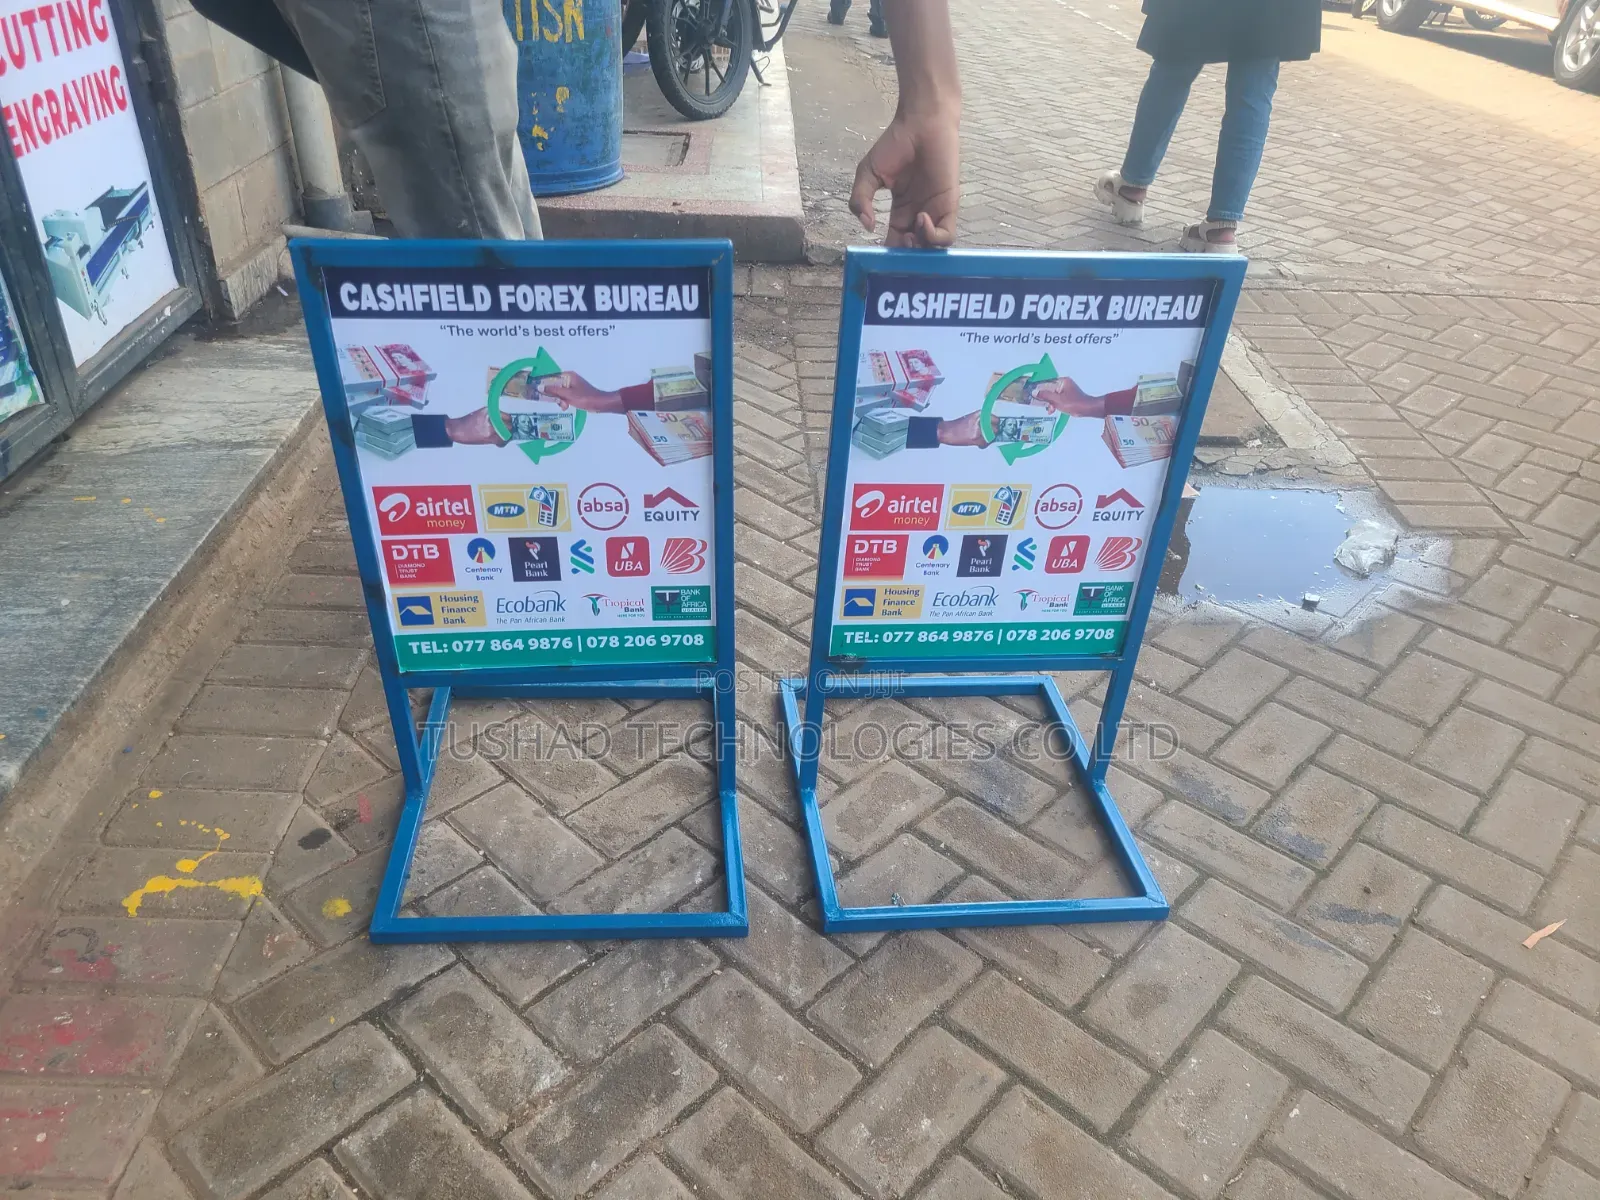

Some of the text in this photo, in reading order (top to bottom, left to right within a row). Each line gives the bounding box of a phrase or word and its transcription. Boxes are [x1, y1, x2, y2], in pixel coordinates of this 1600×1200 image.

[2, 65, 128, 159] ENGRAVING
[340, 282, 700, 312] CASHFIELD FOREX BUREAU
[877, 291, 1204, 322] CASHFIELD FOREX BUREAU
[477, 324, 530, 337] world’s
[534, 324, 564, 337] best
[993, 332, 1041, 345] world’s
[1044, 332, 1072, 345] best
[415, 496, 473, 517] airtel
[493, 505, 518, 515] MTN
[583, 497, 624, 513] absa
[887, 495, 938, 514] airtel
[957, 504, 982, 514] MTN
[1039, 497, 1077, 512] absa
[644, 510, 701, 522] EQUITY
[893, 516, 931, 527] money
[1092, 510, 1145, 522] EQUITY
[426, 519, 466, 530] money
[391, 543, 440, 560] DTB
[854, 539, 898, 554] DTB
[524, 560, 548, 569] Pearl
[614, 560, 643, 572] UBA
[915, 561, 951, 569] Centenary
[970, 557, 993, 566] Pearl
[1051, 558, 1079, 569] UBA
[464, 566, 503, 574] Centenary
[525, 569, 549, 577] Bank
[969, 565, 991, 574] Bank
[680, 588, 701, 596] BANK
[884, 587, 920, 597] Housing
[1104, 584, 1125, 592] BANK
[439, 594, 480, 603] Housing
[496, 590, 567, 613] Ecobank
[932, 585, 1000, 607] Ecobank
[1031, 594, 1070, 605] Tropical
[602, 598, 645, 608] Tropical
[883, 598, 916, 606] Finance
[441, 605, 477, 614] Finance
[882, 608, 903, 616] Bank
[929, 610, 940, 618] The
[443, 616, 466, 625] Bank
[495, 617, 508, 625] The
[524, 616, 547, 624] African
[844, 631, 880, 644] TEL:
[882, 630, 916, 643] 077
[917, 630, 949, 643] 864
[952, 629, 994, 642] 9876
[1006, 629, 1037, 641] 078
[1040, 628, 1071, 641] 206
[1074, 628, 1115, 640] 9708
[408, 640, 449, 654] TEL:
[452, 639, 485, 653] 077
[490, 638, 524, 652] 864
[528, 636, 573, 651] 9876
[586, 635, 619, 649] 078
[624, 634, 657, 648] 206
[661, 634, 705, 647] 9708
